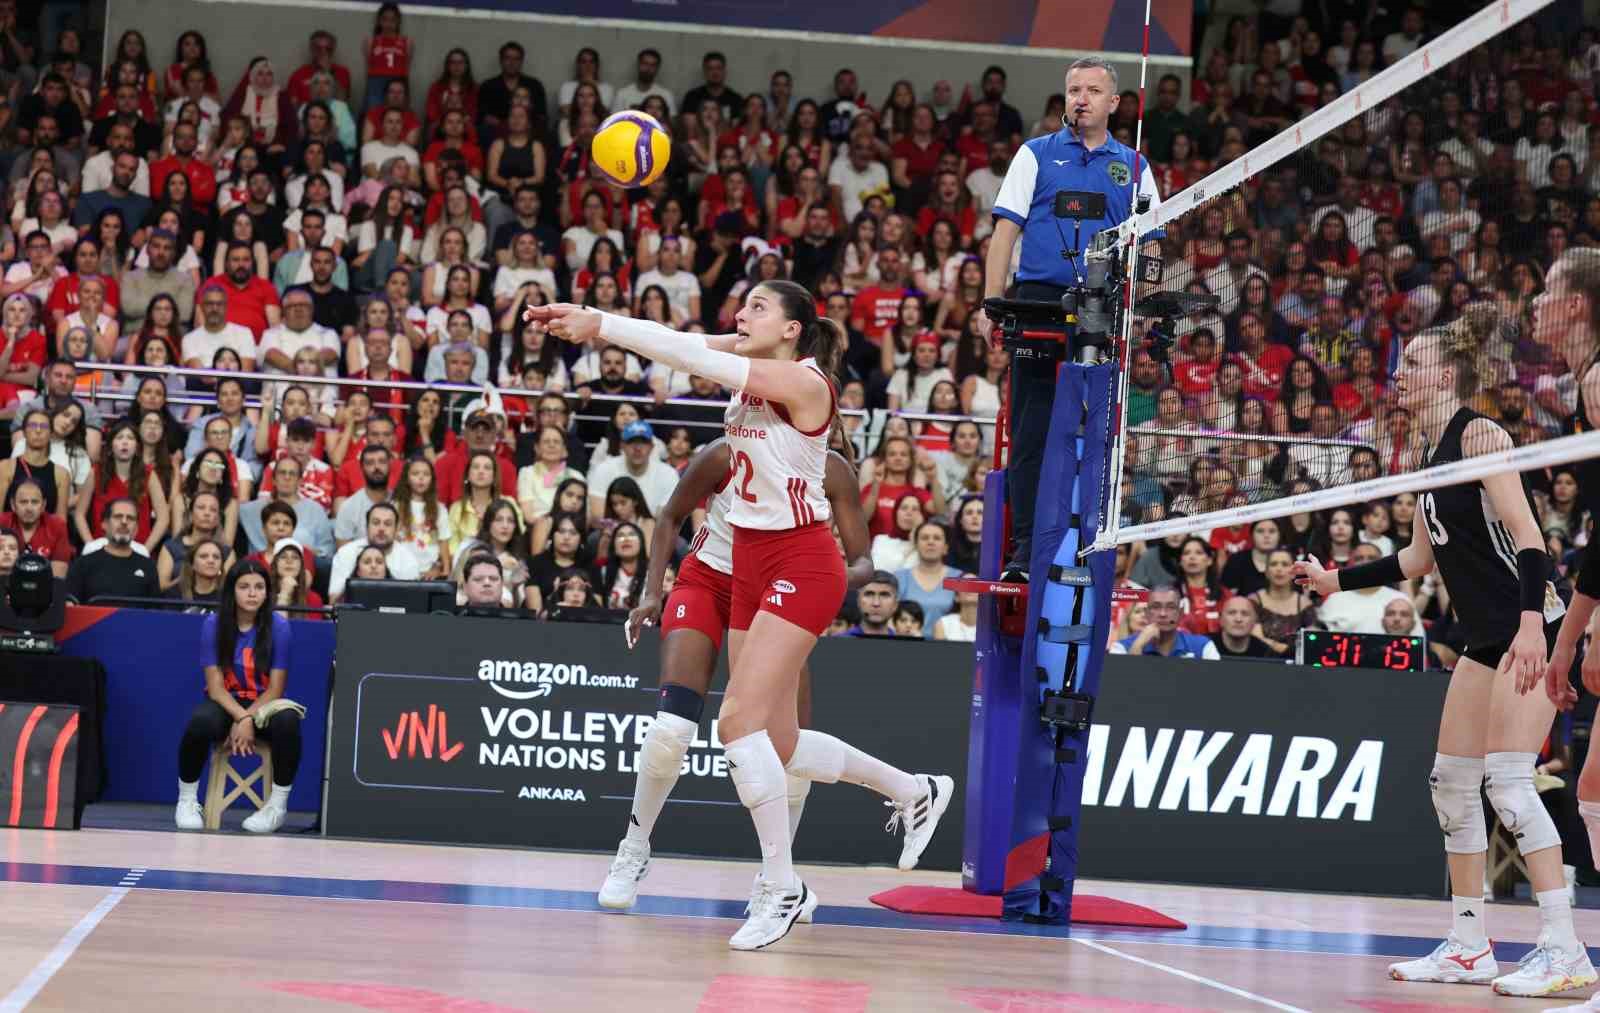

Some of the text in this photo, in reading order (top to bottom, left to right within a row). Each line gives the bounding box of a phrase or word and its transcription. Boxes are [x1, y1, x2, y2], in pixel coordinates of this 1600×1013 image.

[676, 604, 686, 619] 8
[478, 659, 639, 688] amazon.com.tr
[382, 704, 464, 763] VNL
[480, 706, 724, 749] VOLLEYBLL
[479, 743, 729, 777] NATIONS LGUE
[518, 786, 586, 801] ANKARA
